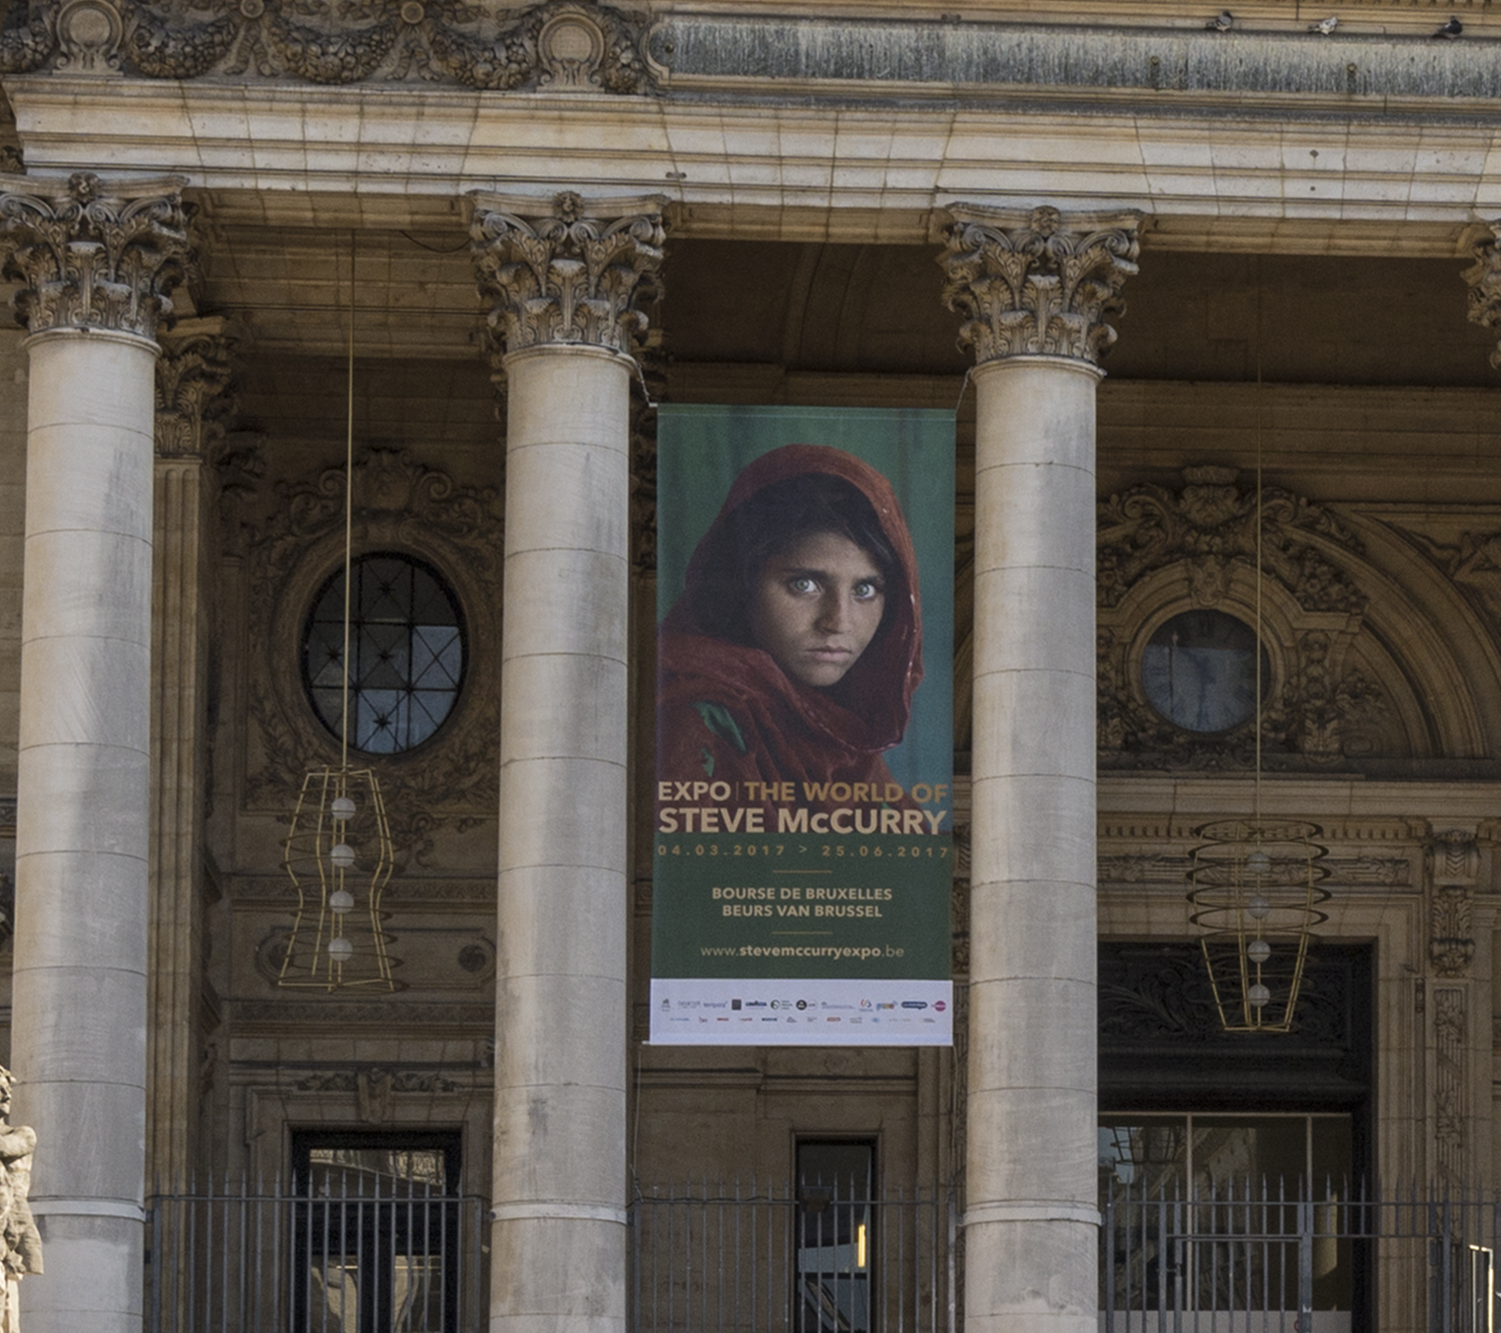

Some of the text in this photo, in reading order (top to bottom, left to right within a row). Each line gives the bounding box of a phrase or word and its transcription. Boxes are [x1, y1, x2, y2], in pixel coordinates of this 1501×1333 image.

[658, 780, 948, 804] EXPO THE WORLD OF
[658, 807, 947, 836] STEVE McCURRY
[657, 844, 949, 858] 04.03.2017 25.06.2017
[711, 887, 893, 901] BOURSE DE BRUXELLES
[722, 904, 883, 918] BEURS VAN BRUSSEL
[700, 944, 905, 960] www.stevemccurryexpo.be
